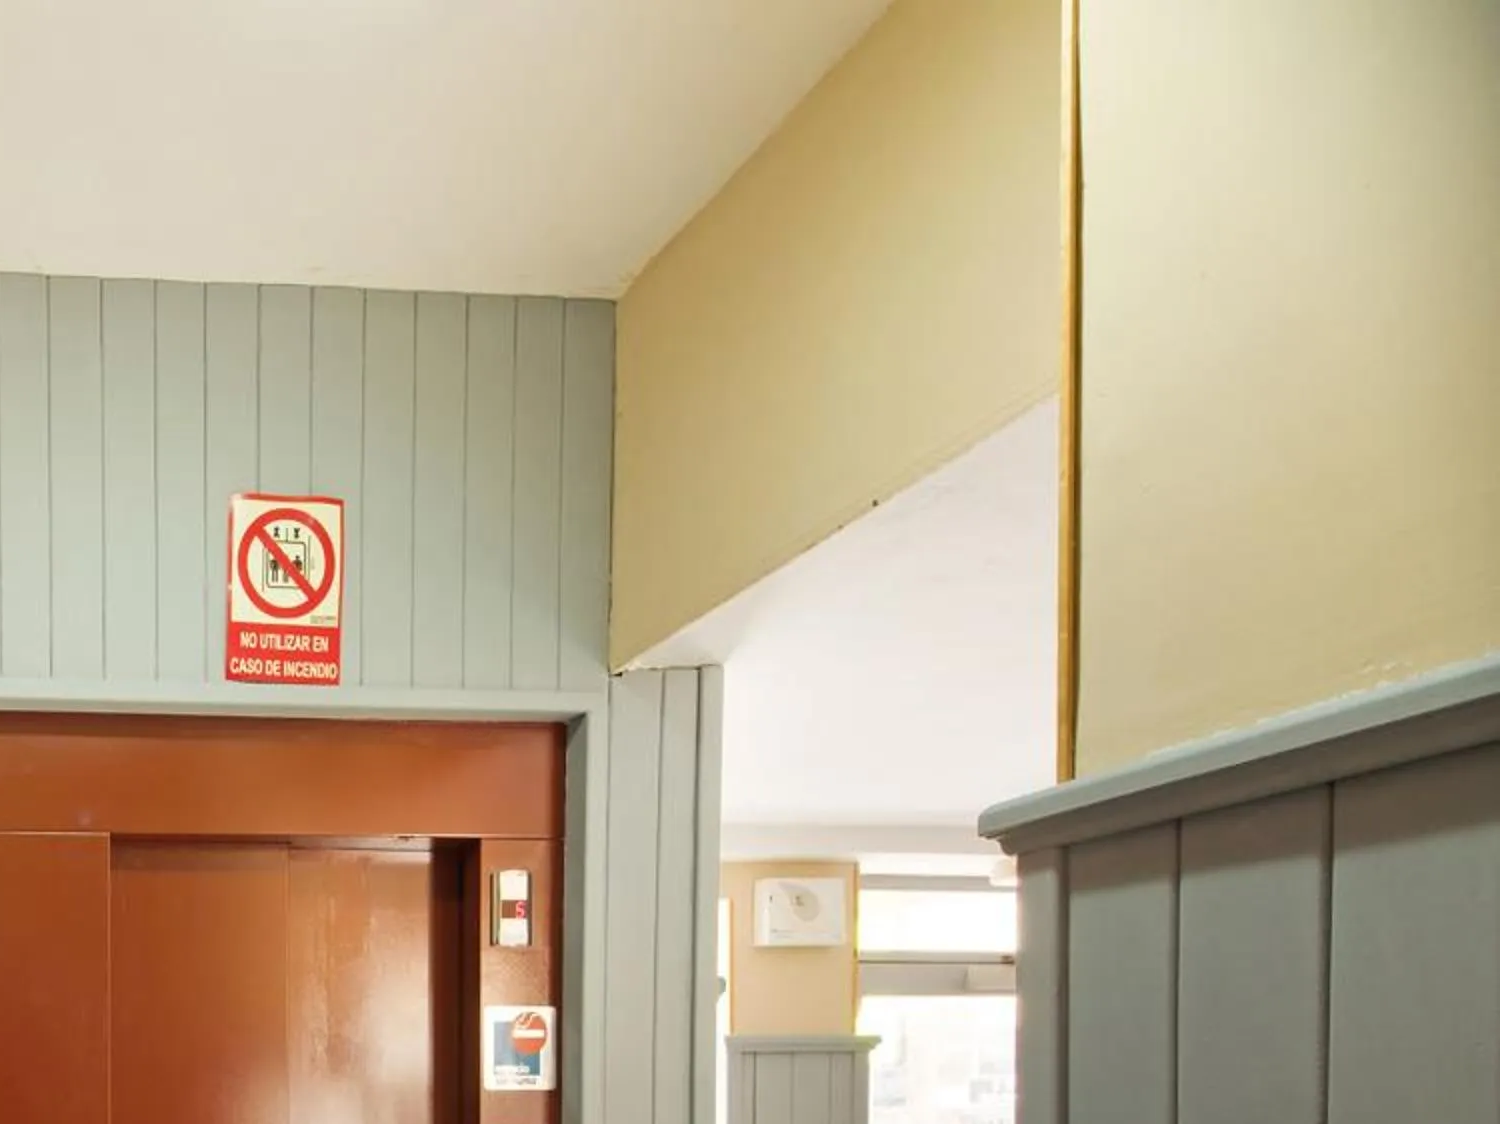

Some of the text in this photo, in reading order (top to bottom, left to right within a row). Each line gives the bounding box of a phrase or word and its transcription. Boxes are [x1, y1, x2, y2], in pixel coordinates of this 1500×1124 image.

[240, 631, 329, 653] NO UTILIZAR EN
[230, 657, 338, 679] CASO DE INCENDIO
